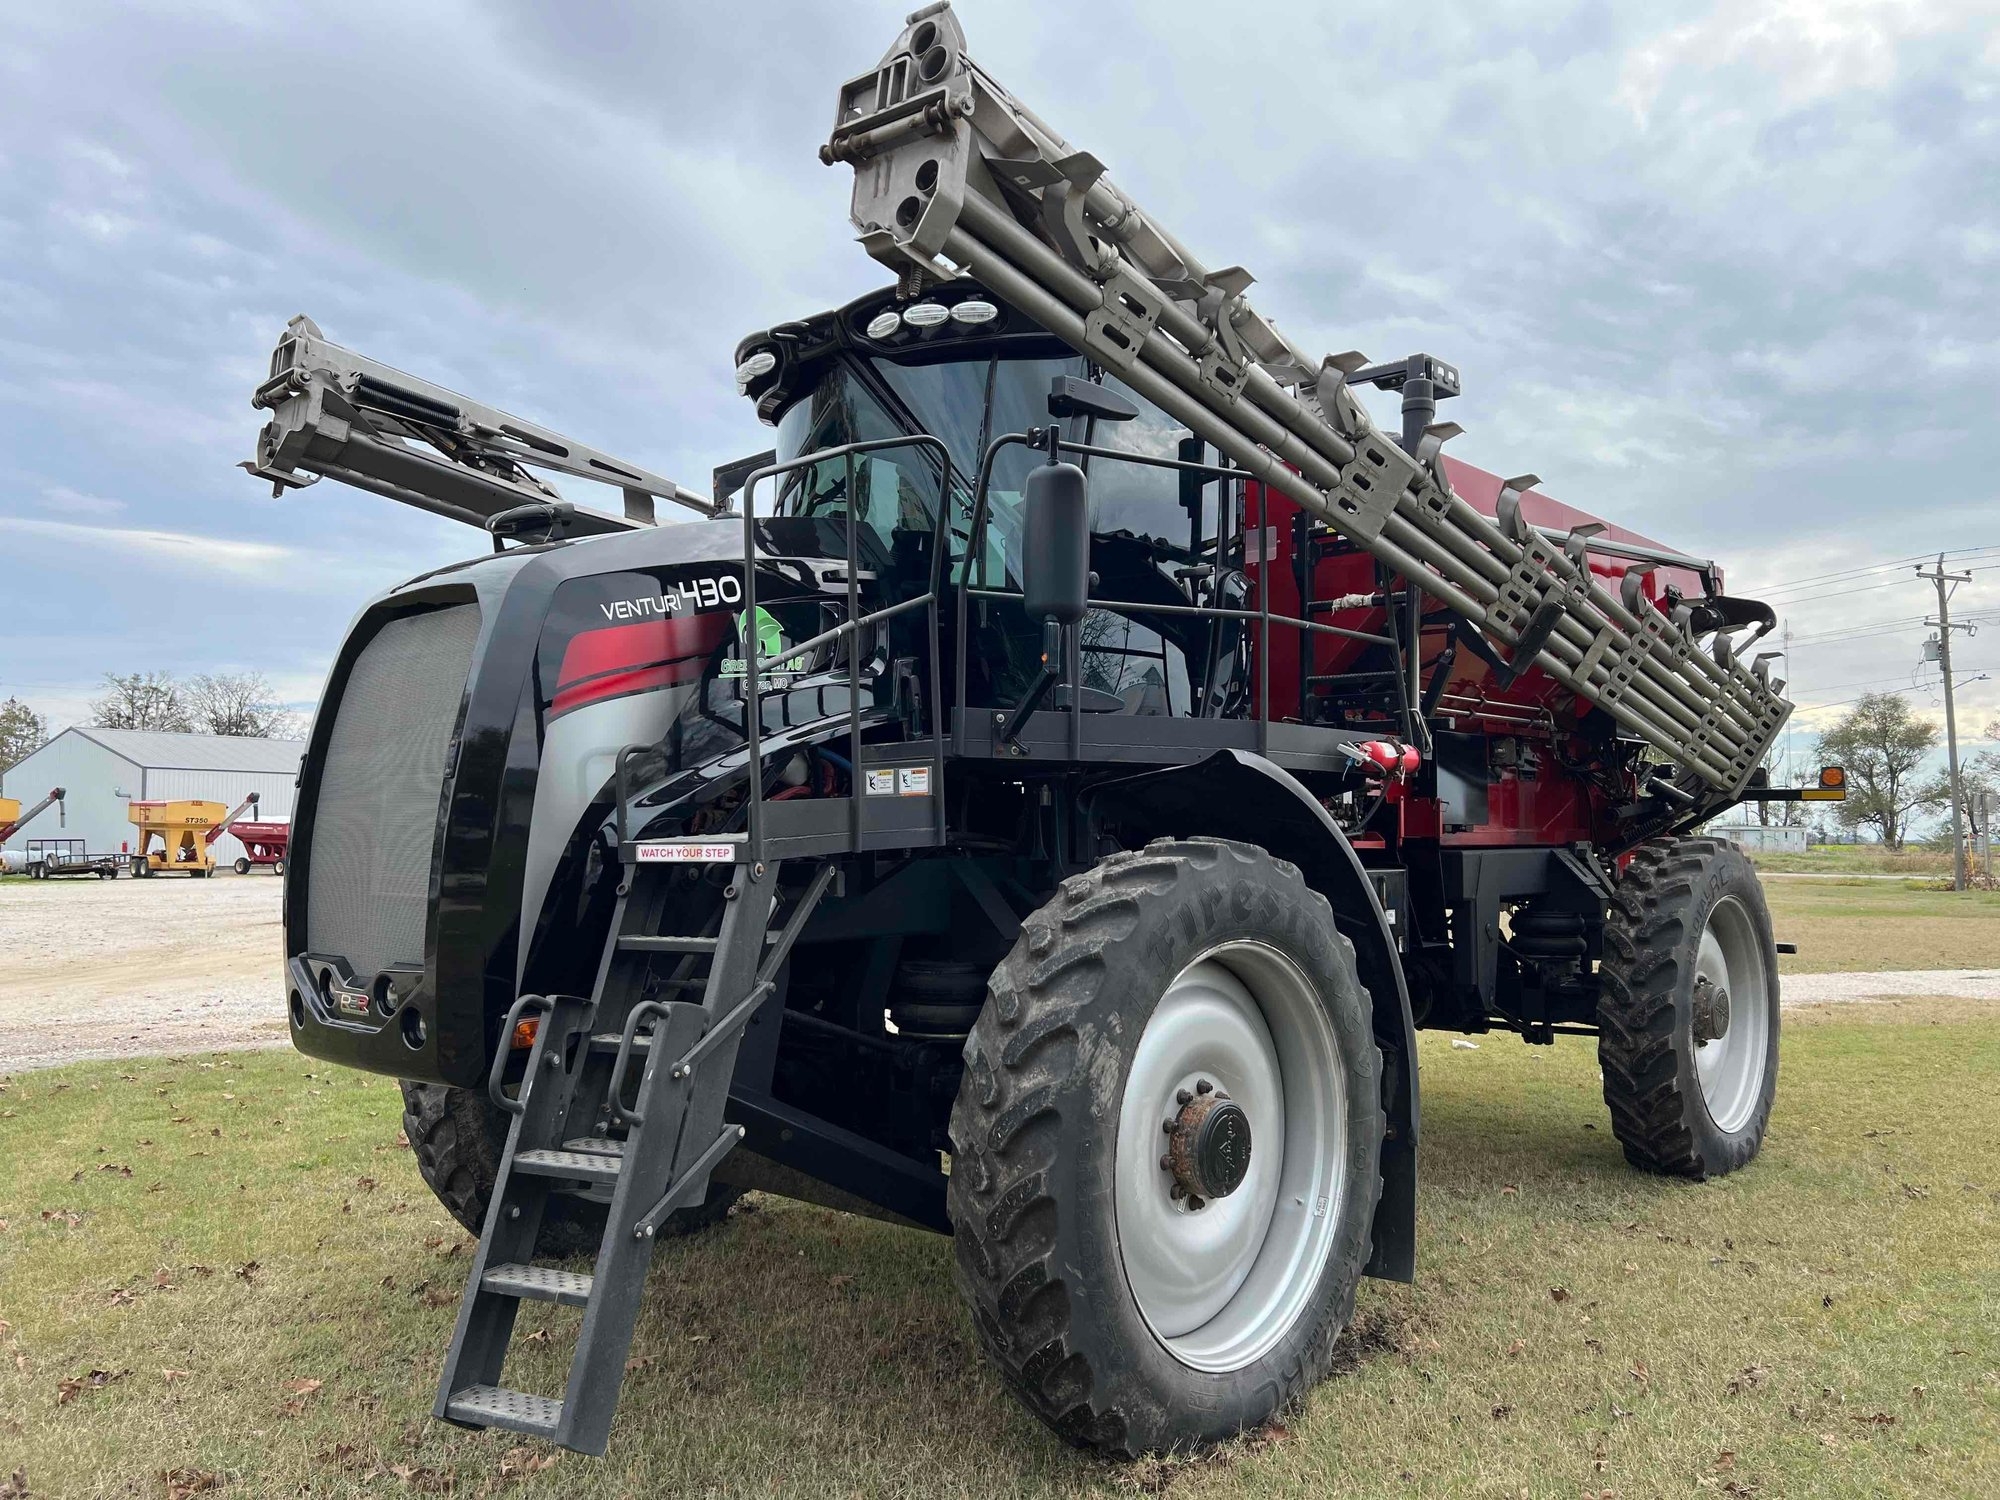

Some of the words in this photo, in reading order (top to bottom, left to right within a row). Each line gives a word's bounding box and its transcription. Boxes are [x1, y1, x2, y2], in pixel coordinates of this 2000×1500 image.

[600, 593, 682, 620] VENTURI
[679, 575, 741, 607] 430
[787, 656, 803, 671] AG
[742, 679, 773, 691] Cron,
[773, 677, 788, 689] MO
[641, 848, 674, 858] WATCH
[676, 848, 703, 858] YOUR
[705, 848, 730, 857] STEP
[1709, 864, 1729, 899] RC
